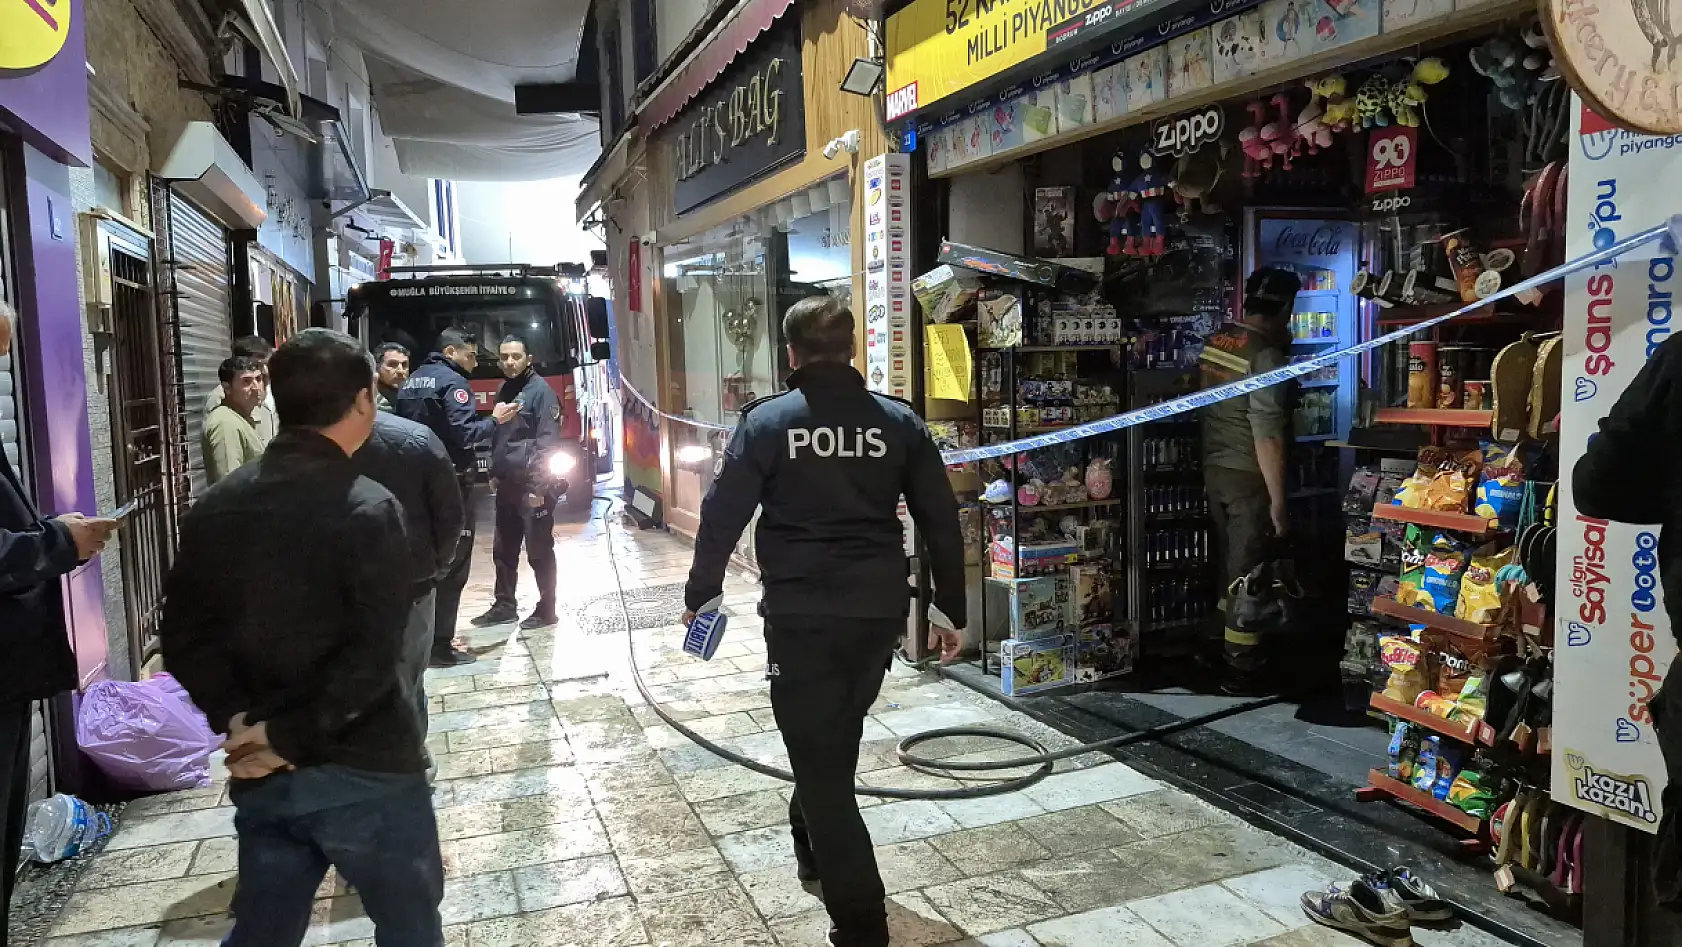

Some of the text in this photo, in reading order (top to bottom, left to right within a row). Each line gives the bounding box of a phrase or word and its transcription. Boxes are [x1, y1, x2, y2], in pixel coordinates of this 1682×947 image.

[945, 0, 969, 35] 52
[1084, 5, 1112, 26] zippo
[729, 57, 785, 147] BAG
[887, 82, 917, 120] MARVEL
[1157, 109, 1220, 149] zippo
[1373, 166, 1406, 182] ZIPPO
[1372, 196, 1411, 212] zippo
[397, 285, 426, 297] MUĞLA
[1646, 256, 1675, 361] mara
[1585, 273, 1614, 376] şans
